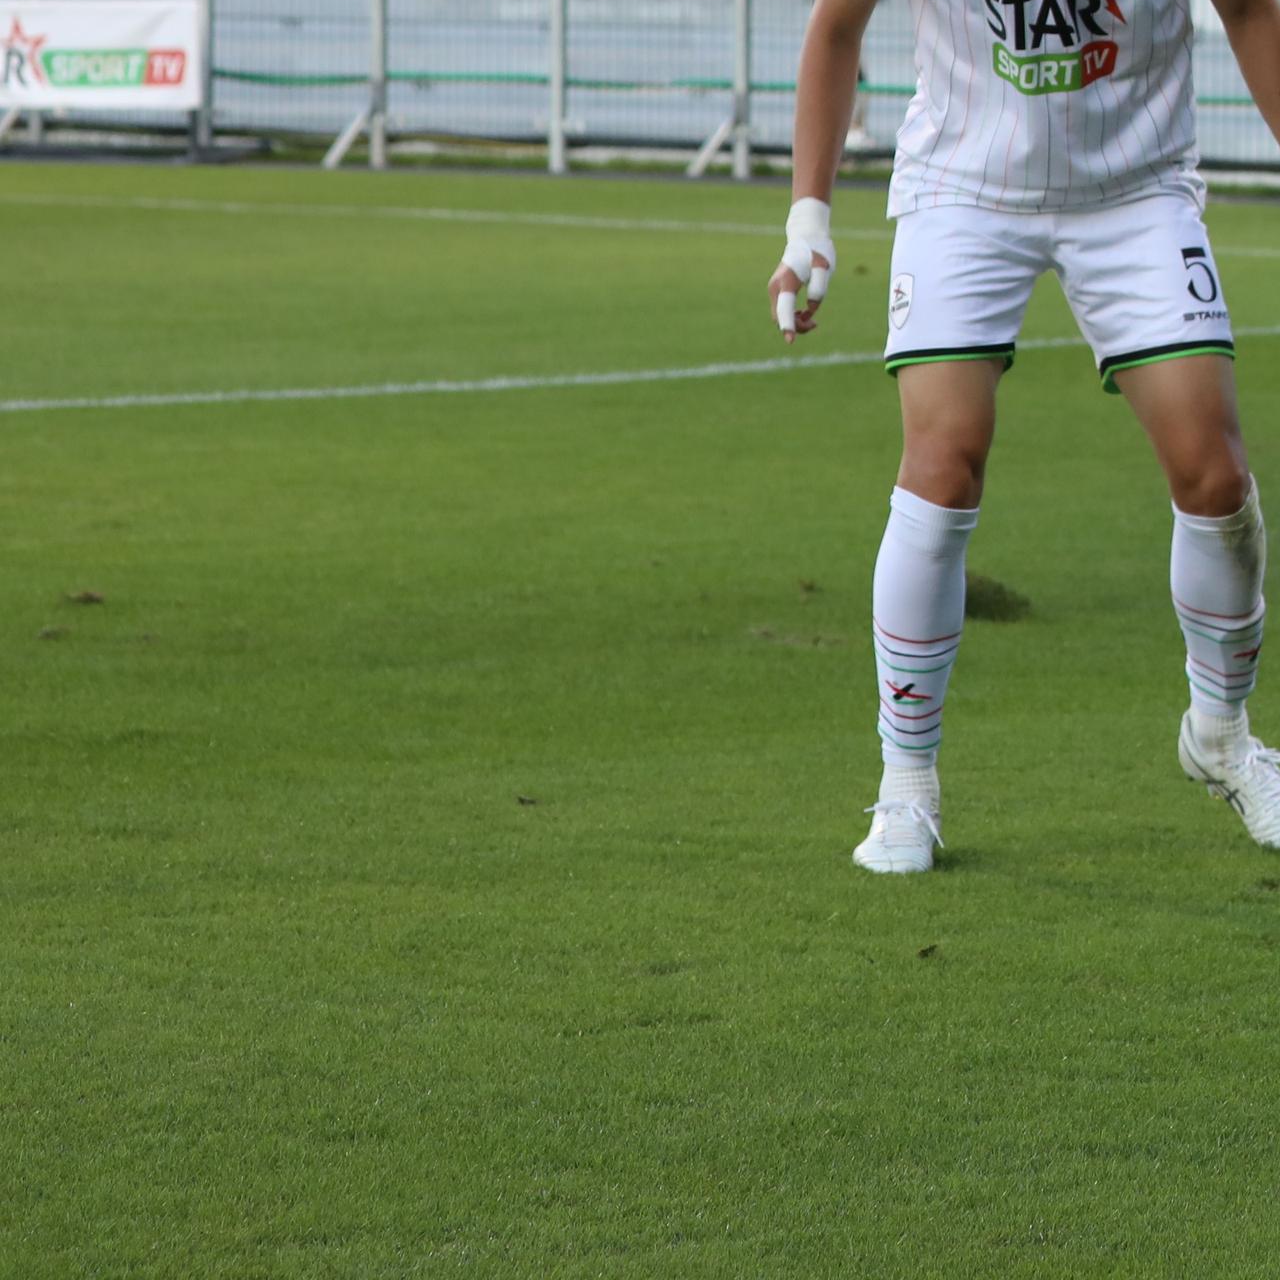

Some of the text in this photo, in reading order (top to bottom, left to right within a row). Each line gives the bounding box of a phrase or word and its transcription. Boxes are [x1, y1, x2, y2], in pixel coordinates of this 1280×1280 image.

[998, 48, 1110, 90] SPORT TV
[1181, 246, 1218, 304] 5
[1183, 311, 1228, 321] STANN
